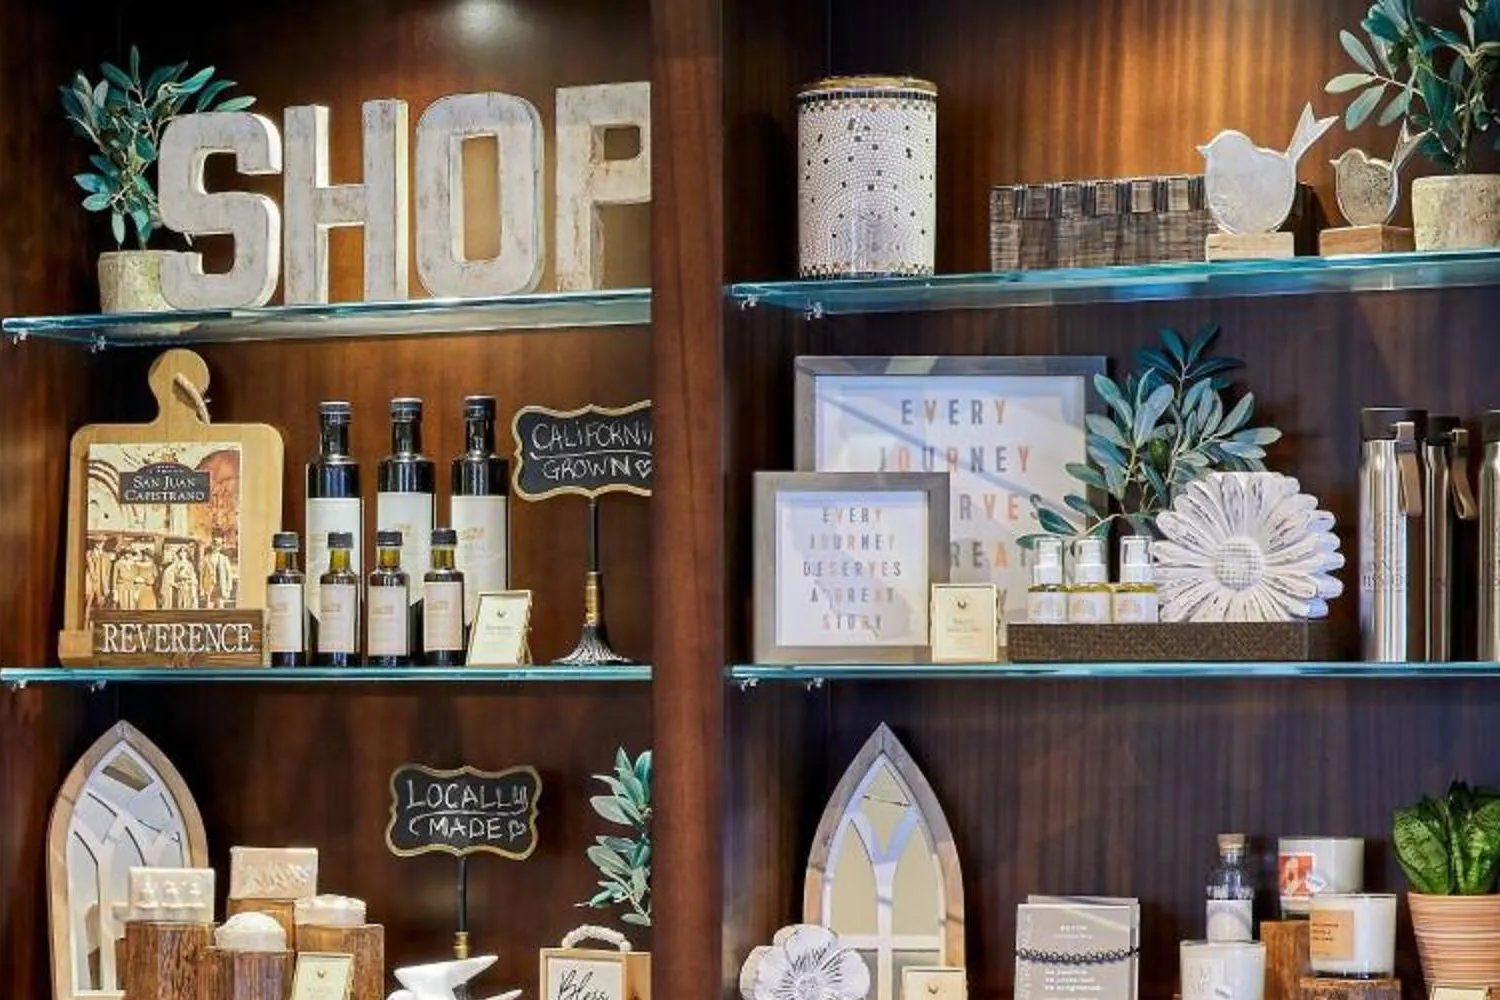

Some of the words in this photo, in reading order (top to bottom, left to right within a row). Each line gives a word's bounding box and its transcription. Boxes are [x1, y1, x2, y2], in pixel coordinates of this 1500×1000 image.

[158, 82, 652, 309] SHOP
[902, 399, 1007, 425] EVERY
[543, 456, 631, 481] GROWN
[877, 444, 1030, 473] JOURNEY
[133, 475, 160, 489] SAN
[163, 475, 197, 490] JUAN
[100, 623, 254, 653] REVERENCE
[405, 779, 529, 815] LOCALLY
[428, 816, 503, 840] MADE
